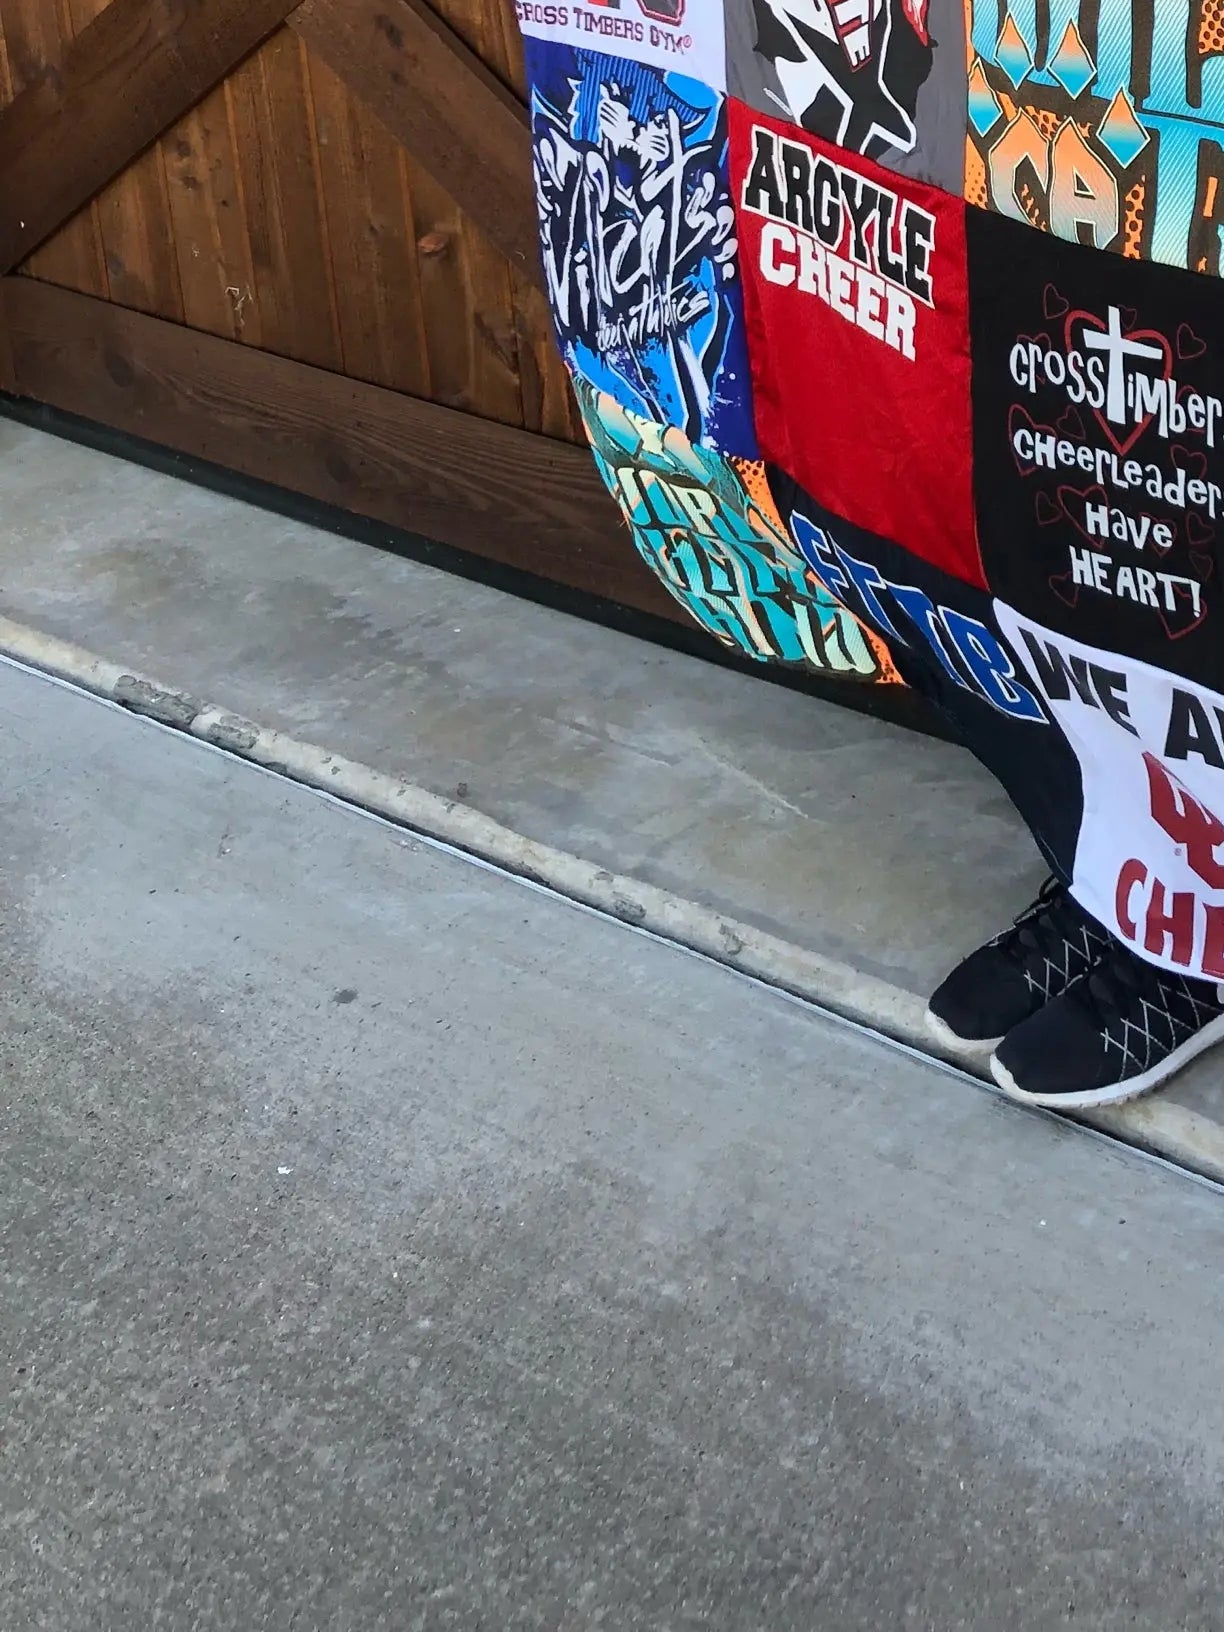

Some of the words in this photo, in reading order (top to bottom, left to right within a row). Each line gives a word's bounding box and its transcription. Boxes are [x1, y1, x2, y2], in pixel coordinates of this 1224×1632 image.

[514, 1, 568, 25] CROSS
[573, 7, 644, 42] TIMBERS
[742, 124, 936, 309] ARGYLE
[760, 222, 917, 361] CHEER
[1086, 501, 1173, 550] Have
[1069, 545, 1201, 617] HEART!
[1021, 626, 1141, 740] WE
